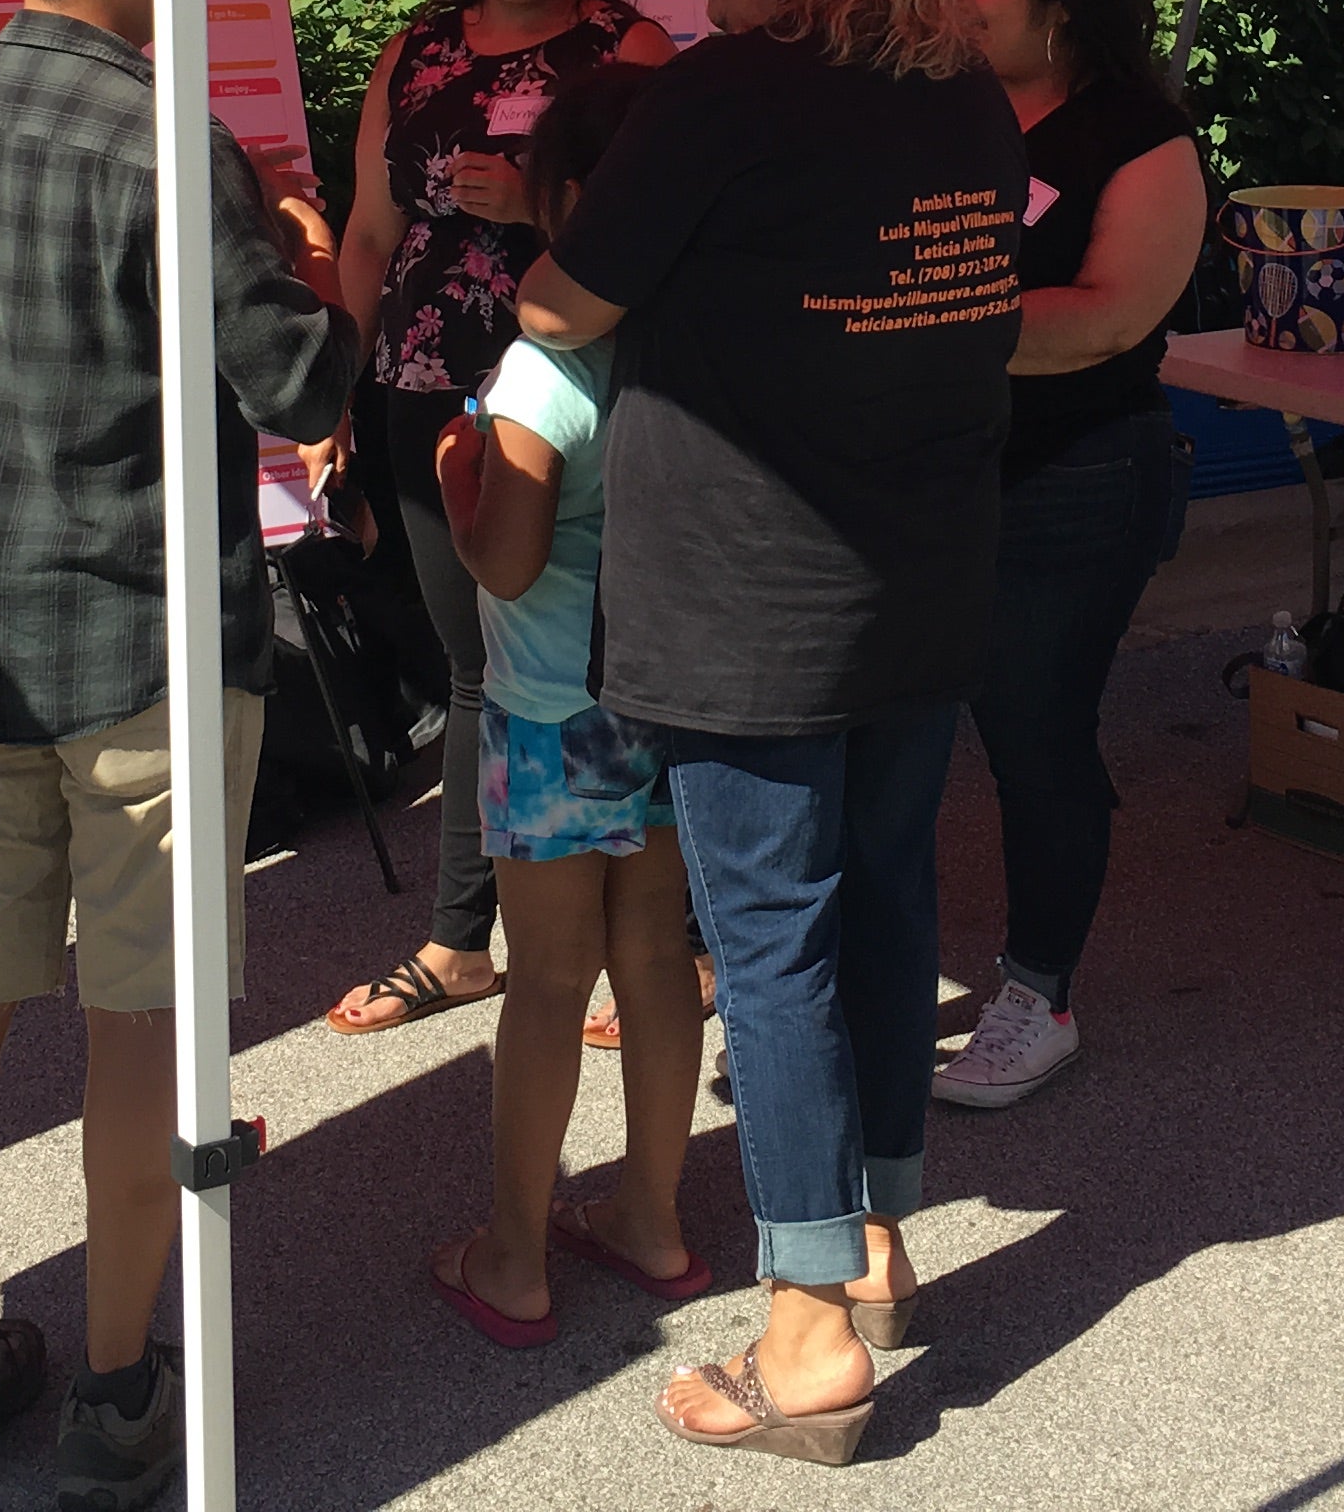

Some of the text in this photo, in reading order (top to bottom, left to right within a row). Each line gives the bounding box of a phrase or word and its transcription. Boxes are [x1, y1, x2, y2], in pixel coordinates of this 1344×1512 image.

[912, 189, 997, 213] Ambit Energy
[879, 224, 910, 241] Luis
[913, 216, 960, 238] Miguel
[915, 234, 995, 260] Leticia Avitia
[889, 270, 914, 286] Tel.
[918, 265, 955, 284] (708)
